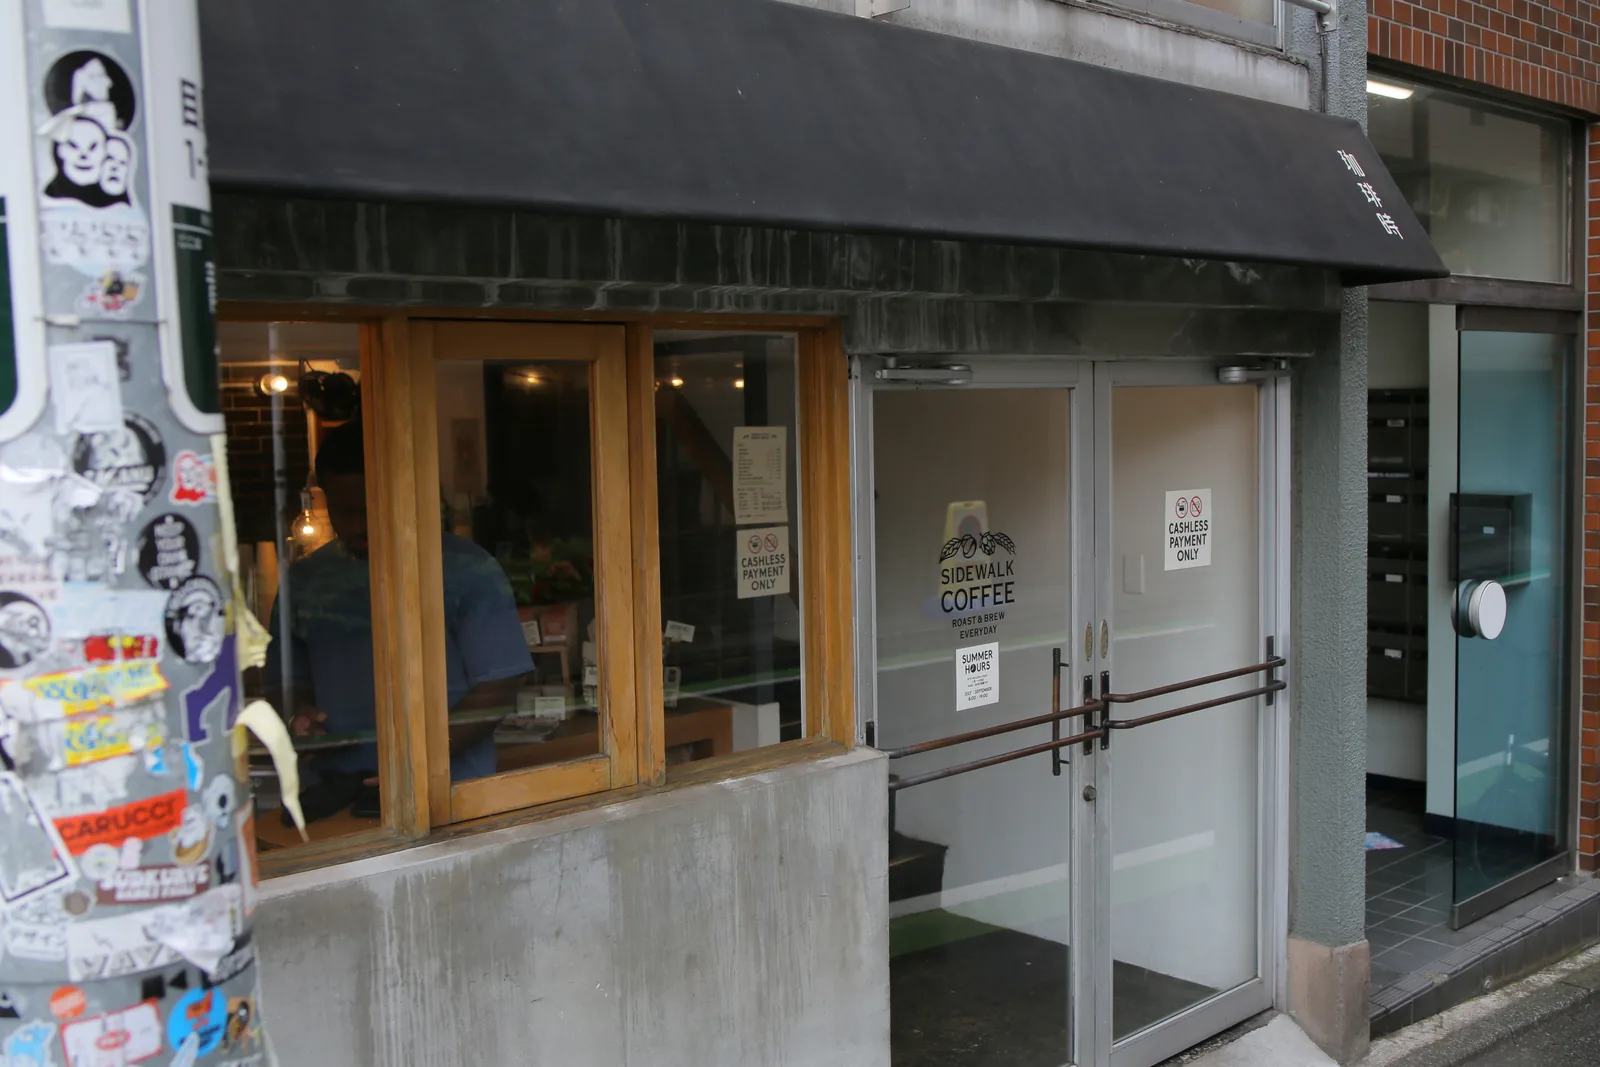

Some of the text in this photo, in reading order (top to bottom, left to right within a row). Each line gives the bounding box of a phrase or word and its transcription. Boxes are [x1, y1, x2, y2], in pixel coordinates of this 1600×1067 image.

[1337, 149, 1404, 239] 珈琲時
[1169, 519, 1209, 535] CASHLESS
[1169, 533, 1207, 549] PAYMENT
[742, 553, 785, 568] CASHLESS
[1177, 548, 1199, 562] ONLY
[743, 565, 785, 581] PAYMENT
[941, 560, 1014, 585] SIDEWALK
[751, 578, 776, 591] ONLY
[941, 581, 1015, 613] COFFEE
[952, 611, 1005, 628] ROAST & BREW
[960, 625, 997, 639] EVERYDAY
[962, 649, 993, 664] SUMMER
[965, 661, 991, 674] HOURS
